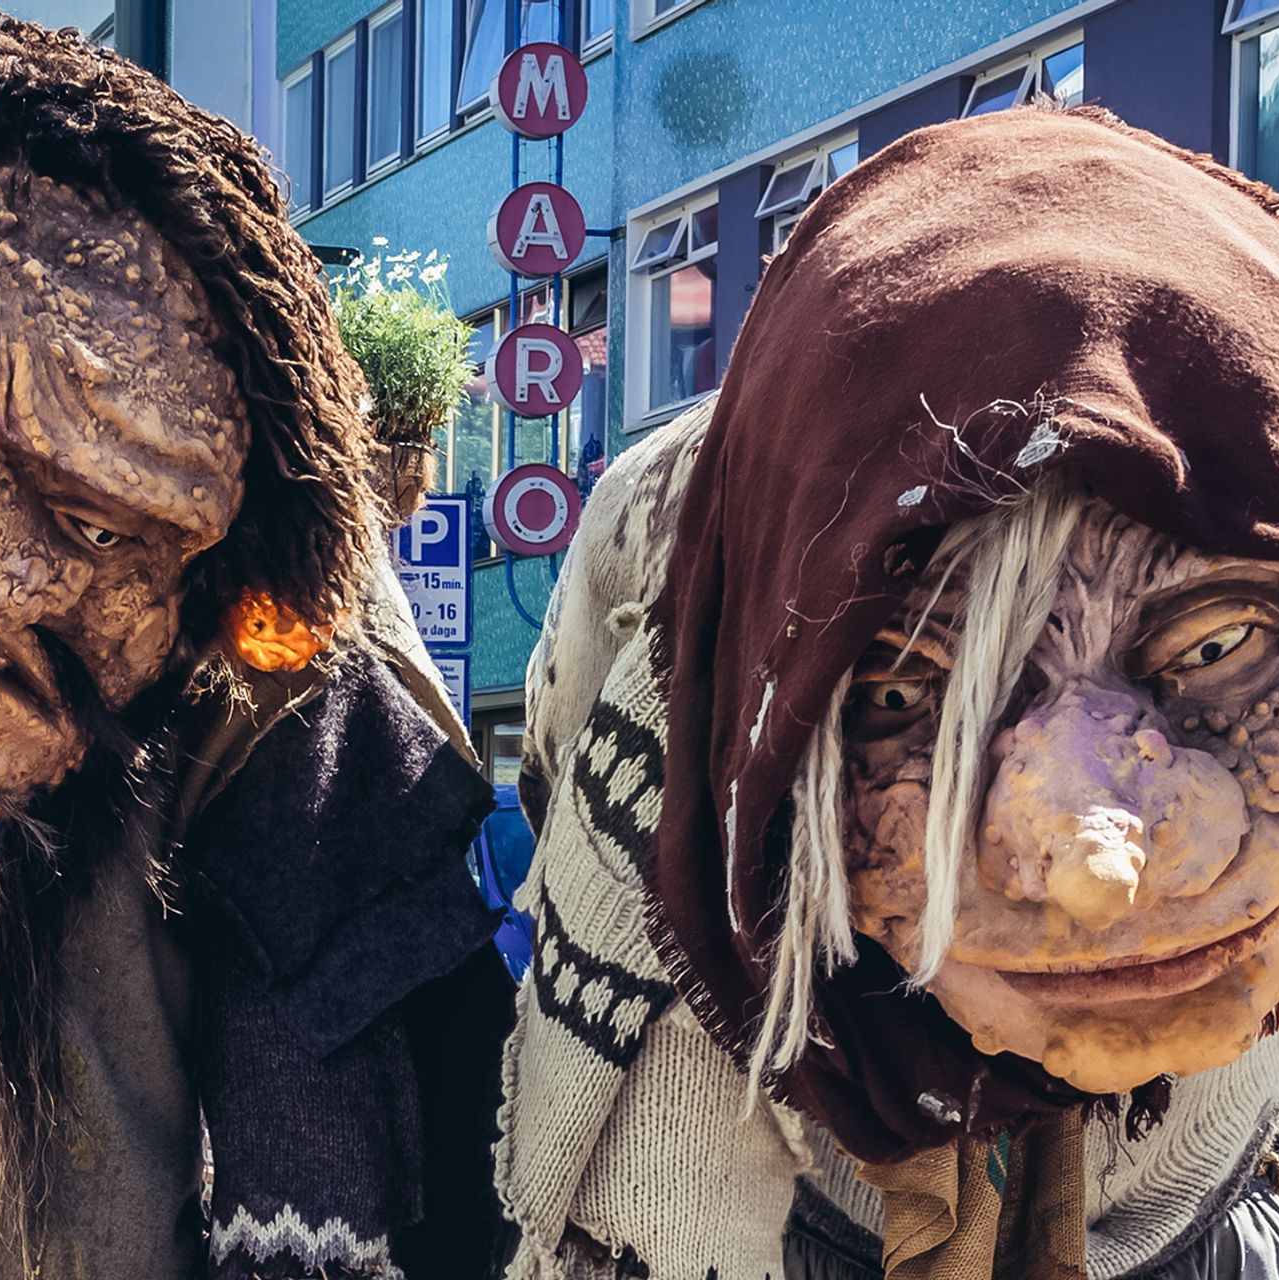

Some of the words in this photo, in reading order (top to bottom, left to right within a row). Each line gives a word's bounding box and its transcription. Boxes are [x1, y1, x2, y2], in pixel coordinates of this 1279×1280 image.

[411, 510, 449, 561] P
[422, 572, 440, 589] 15
[442, 579, 464, 590] min.
[438, 603, 457, 620] 16
[430, 624, 457, 639] daga
